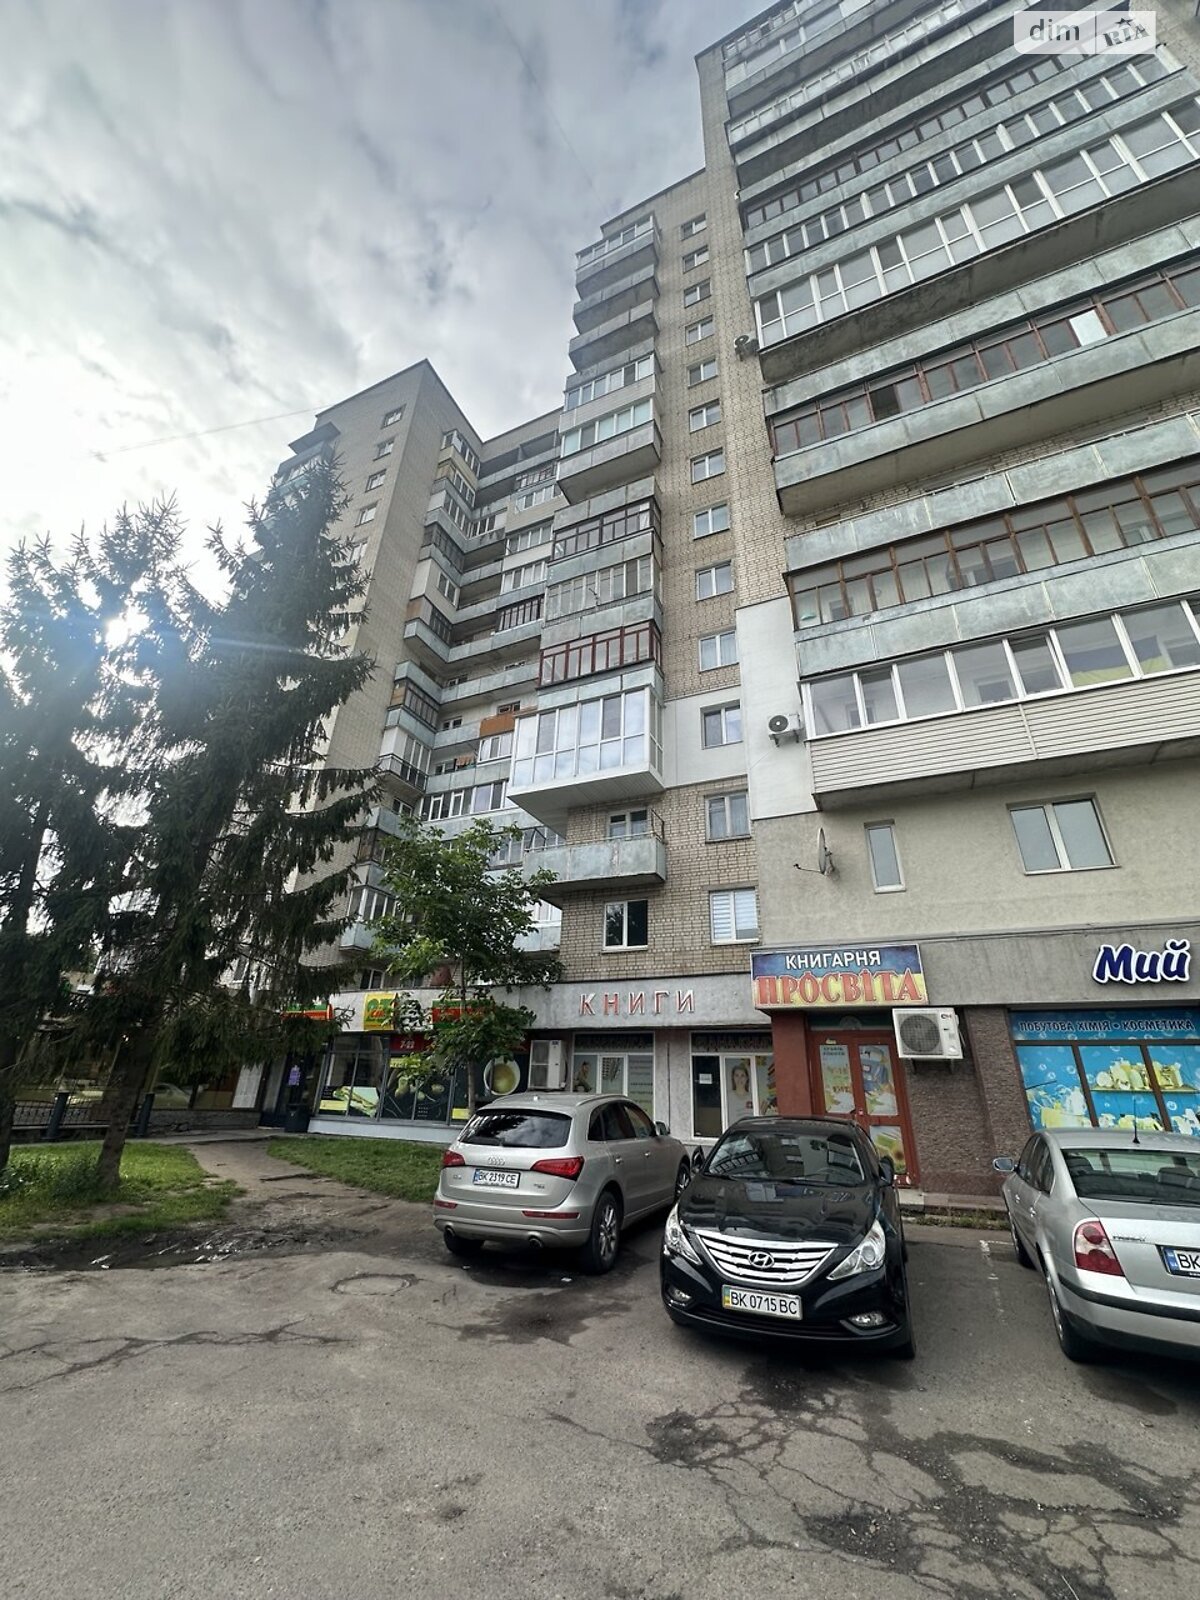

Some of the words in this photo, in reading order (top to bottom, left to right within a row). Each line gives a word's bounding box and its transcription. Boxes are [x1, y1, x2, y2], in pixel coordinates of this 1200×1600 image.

[785, 950, 881, 970] КНИГАРНЯ
[1092, 939, 1191, 984] Мий
[756, 968, 923, 1005] ПРОСВІТА
[579, 989, 696, 1016] КНИГИ
[1018, 1020, 1075, 1032] ПОБУТОВА
[1077, 1020, 1112, 1031] ХІМІЯ
[1122, 1019, 1196, 1031] КОСМЕТИКА
[1177, 1253, 1200, 1270] BK
[730, 1291, 747, 1307] BK
[749, 1294, 777, 1312] 0715
[779, 1299, 797, 1315] BC
